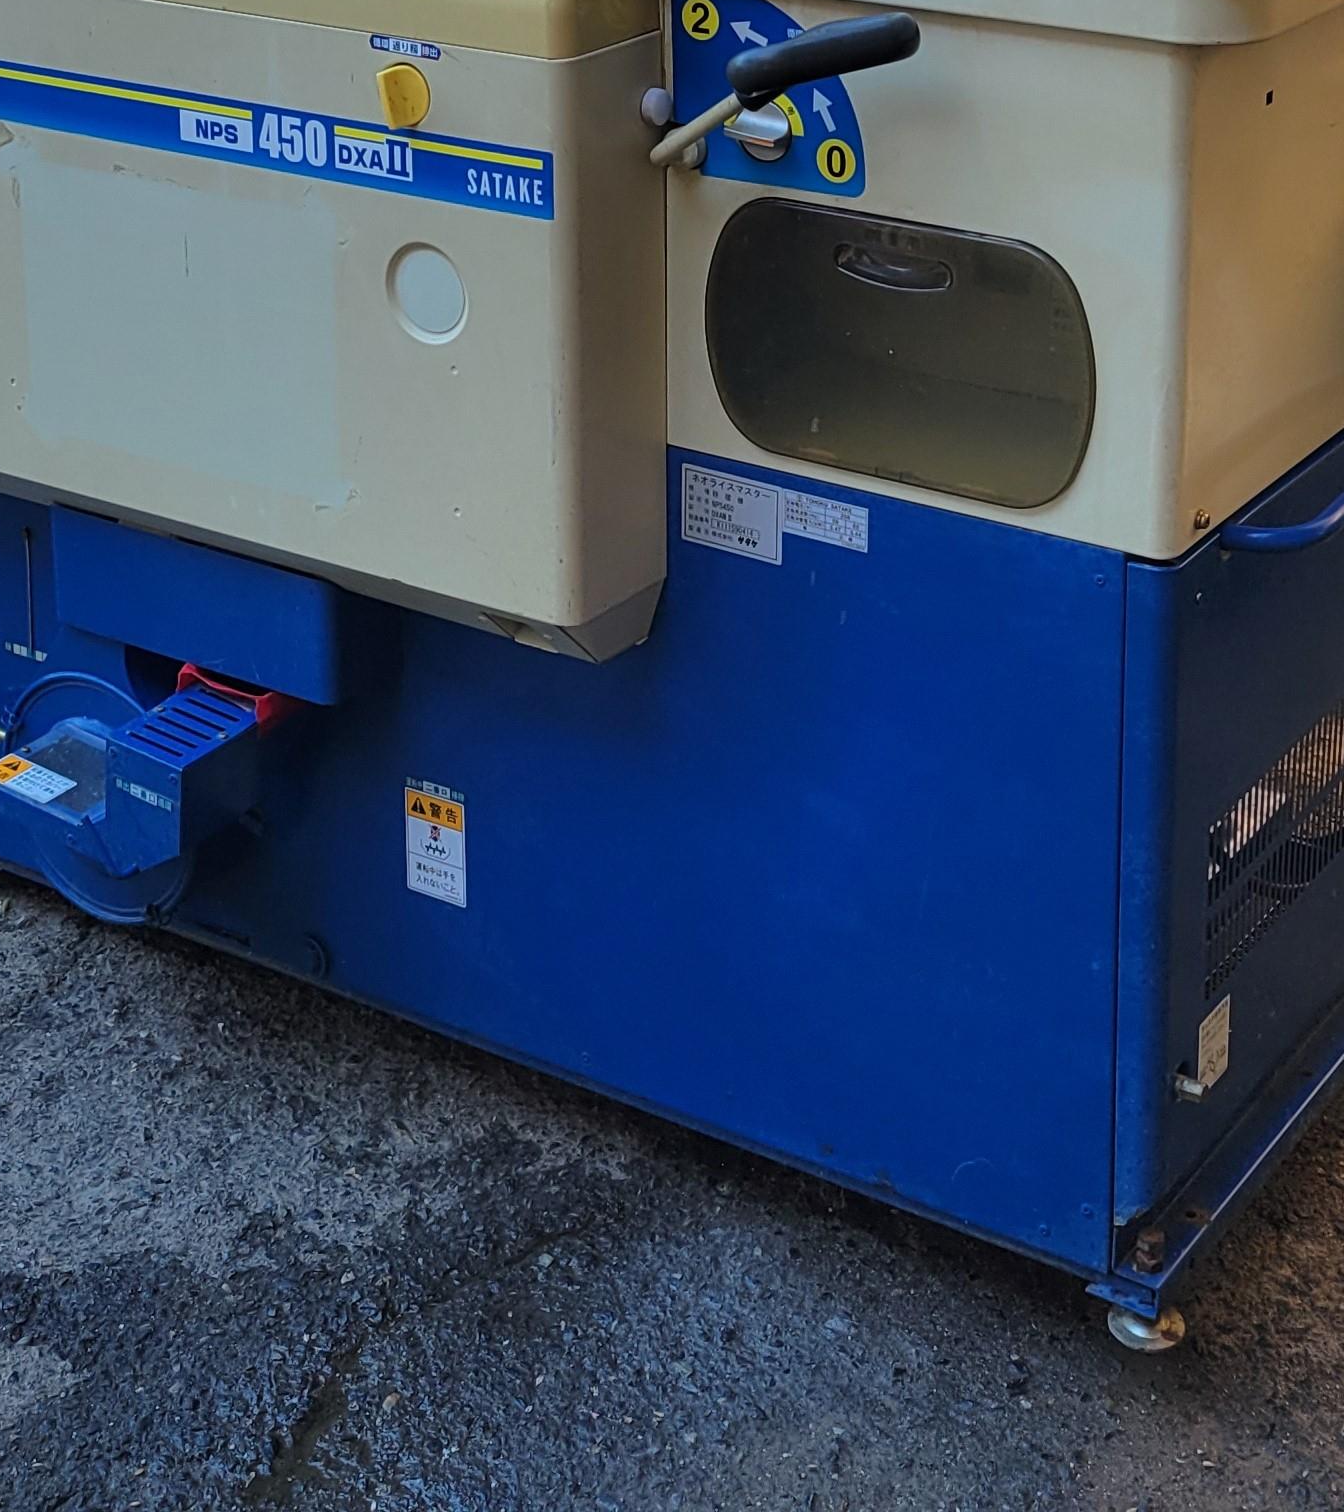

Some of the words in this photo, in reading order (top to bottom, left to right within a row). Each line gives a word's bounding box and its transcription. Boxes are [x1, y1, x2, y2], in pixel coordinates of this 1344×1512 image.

[691, 2, 710, 35] 2
[195, 118, 238, 145] NPS
[258, 112, 328, 167] 450
[467, 168, 544, 206] SATAKE
[826, 145, 846, 178] 0
[692, 474, 771, 498] ネオライスマスター
[429, 801, 458, 825] 警告
